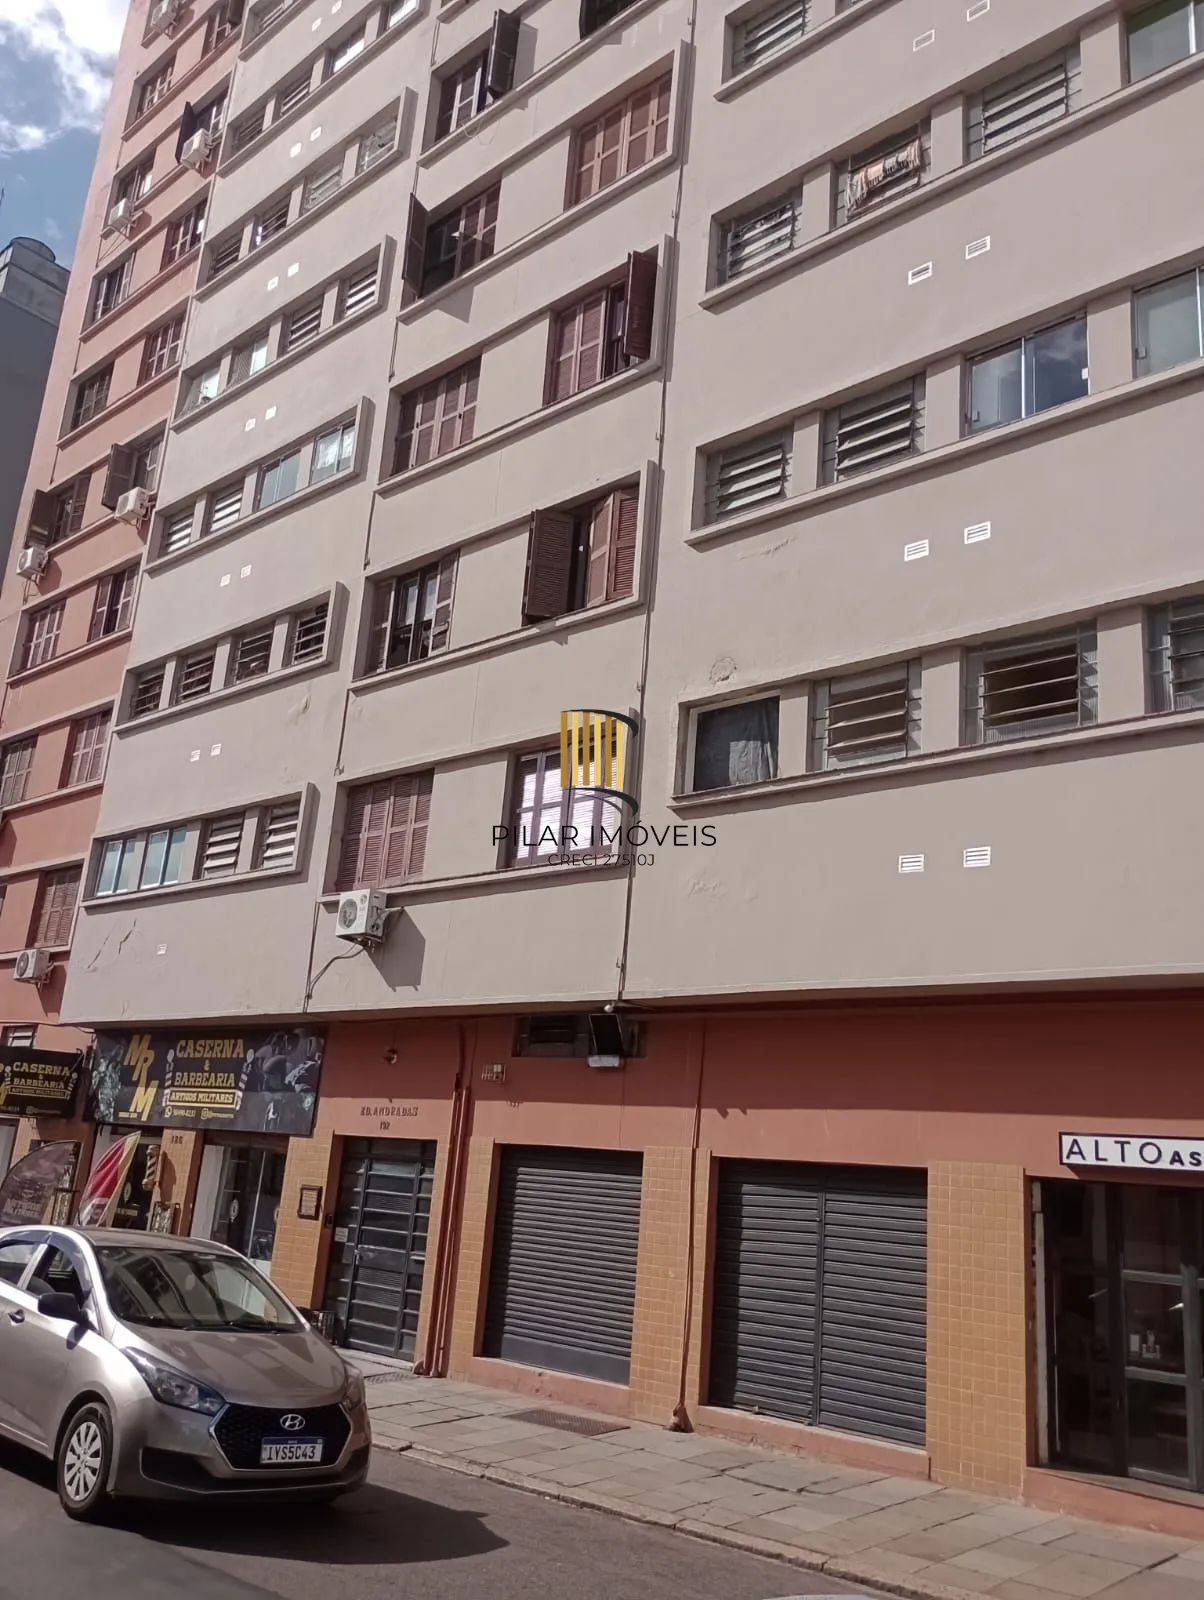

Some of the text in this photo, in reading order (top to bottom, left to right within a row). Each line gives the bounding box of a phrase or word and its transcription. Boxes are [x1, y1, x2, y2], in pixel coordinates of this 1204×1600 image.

[176, 1039, 244, 1059] CASERNA
[12, 1061, 71, 1077] CASERNA
[203, 1059, 210, 1071] &
[13, 1077, 65, 1089] BARBEARIA
[174, 1071, 236, 1087] BARBEARIA
[170, 1091, 234, 1104] ARTIGOS MILITARES
[1065, 1138, 1202, 1167] ALTO AS
